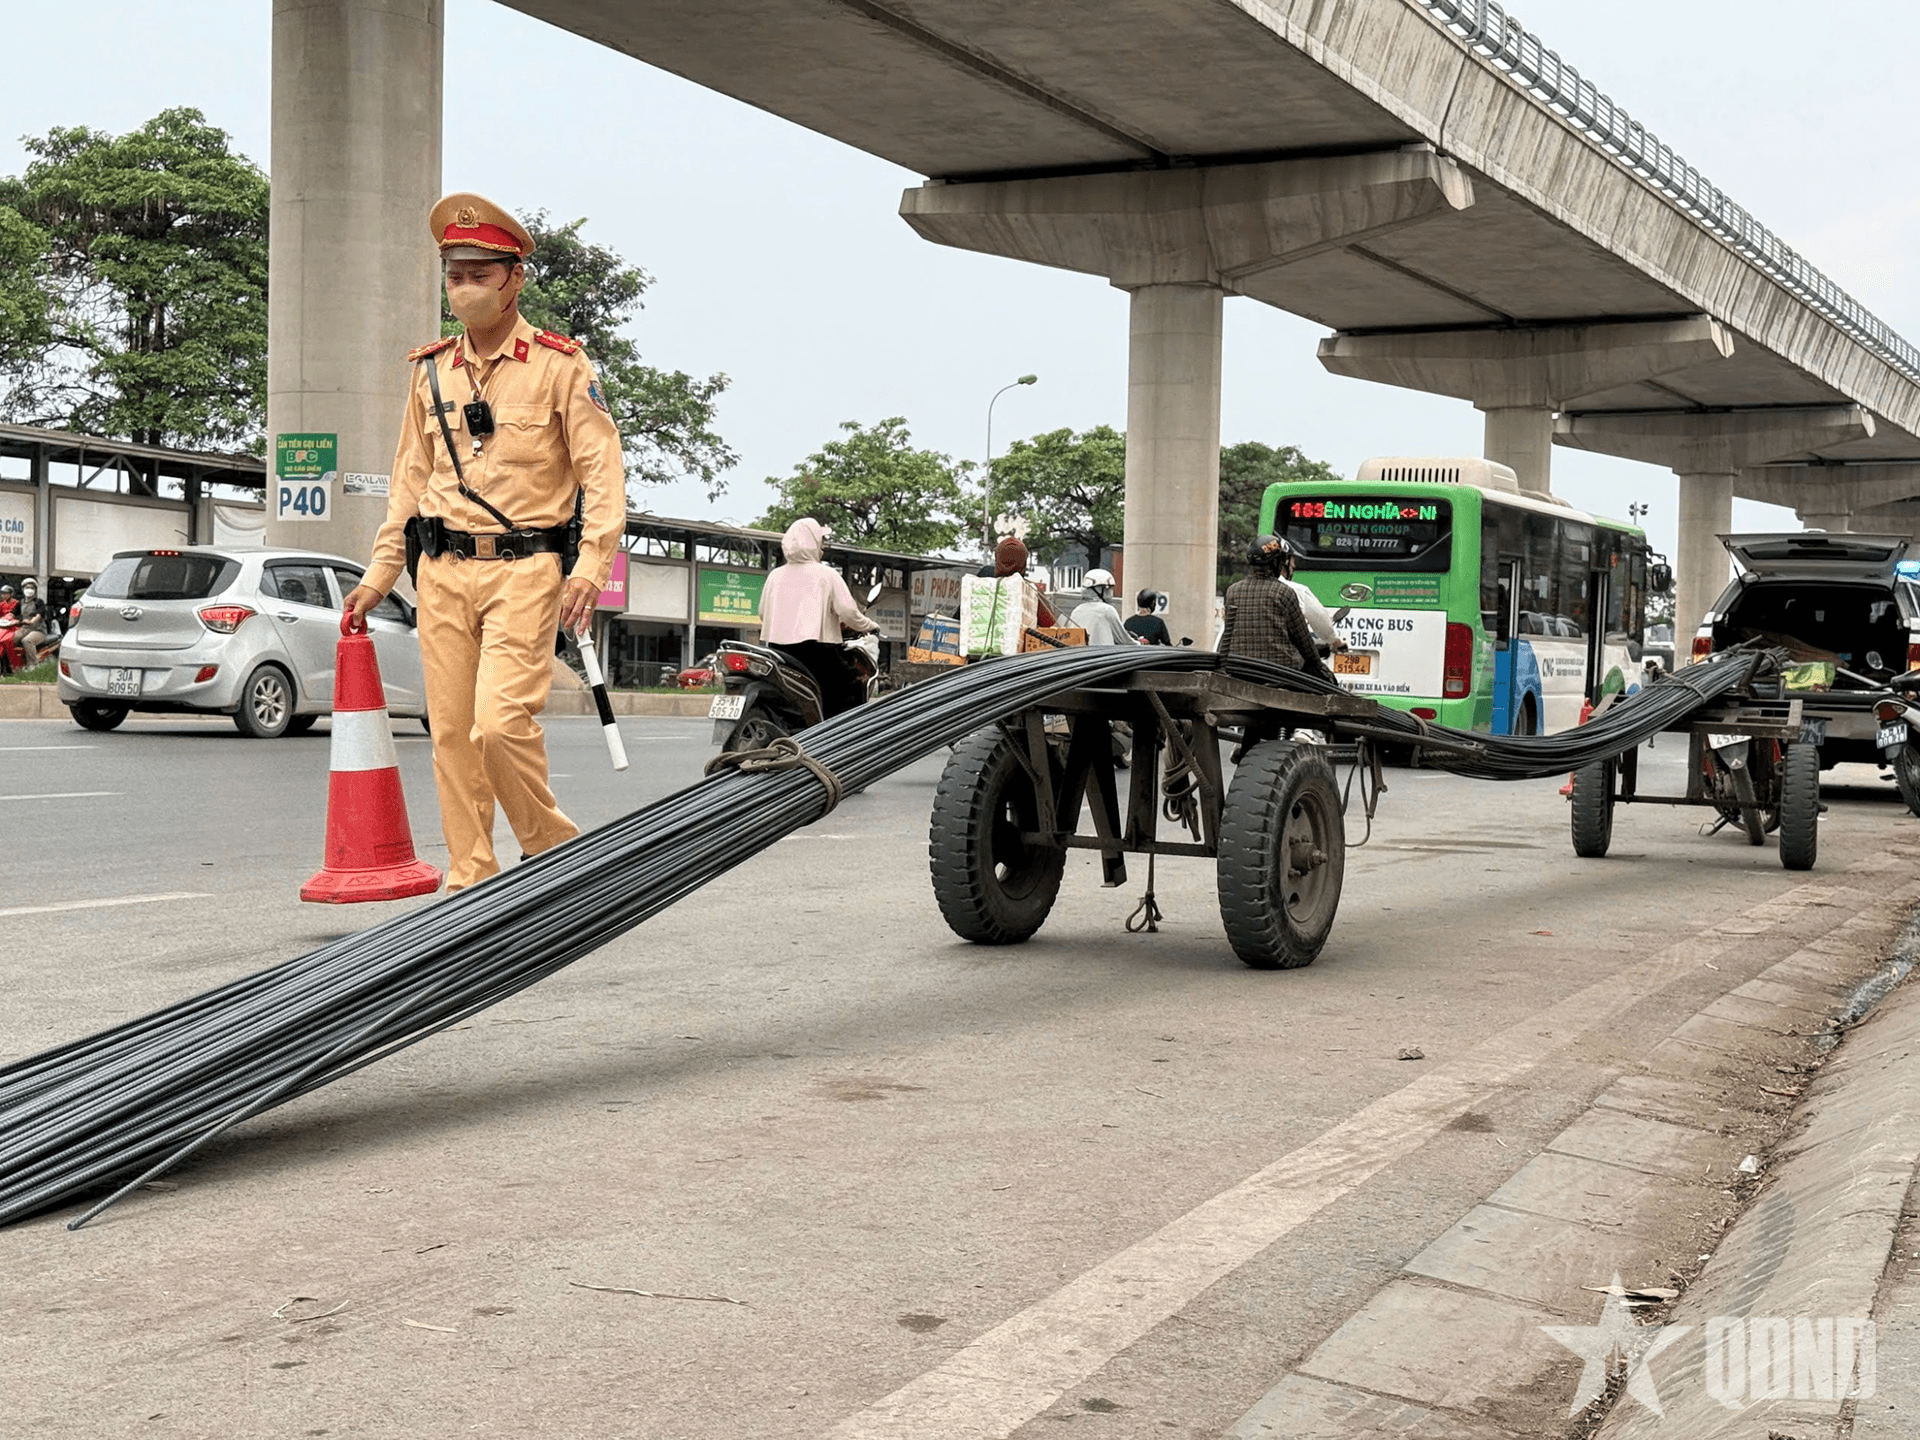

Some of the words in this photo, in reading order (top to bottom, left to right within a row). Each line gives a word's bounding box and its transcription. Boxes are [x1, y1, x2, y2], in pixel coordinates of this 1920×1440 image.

[280, 486, 326, 516] P40
[1349, 502, 1400, 519] NGHĨA
[5, 518, 24, 533] CÁO
[1372, 538, 1399, 547] 77777
[1357, 618, 1384, 630] CNG
[1388, 619, 1414, 631] BUS
[1350, 632, 1384, 647] 515.44
[116, 670, 133, 682] 30A
